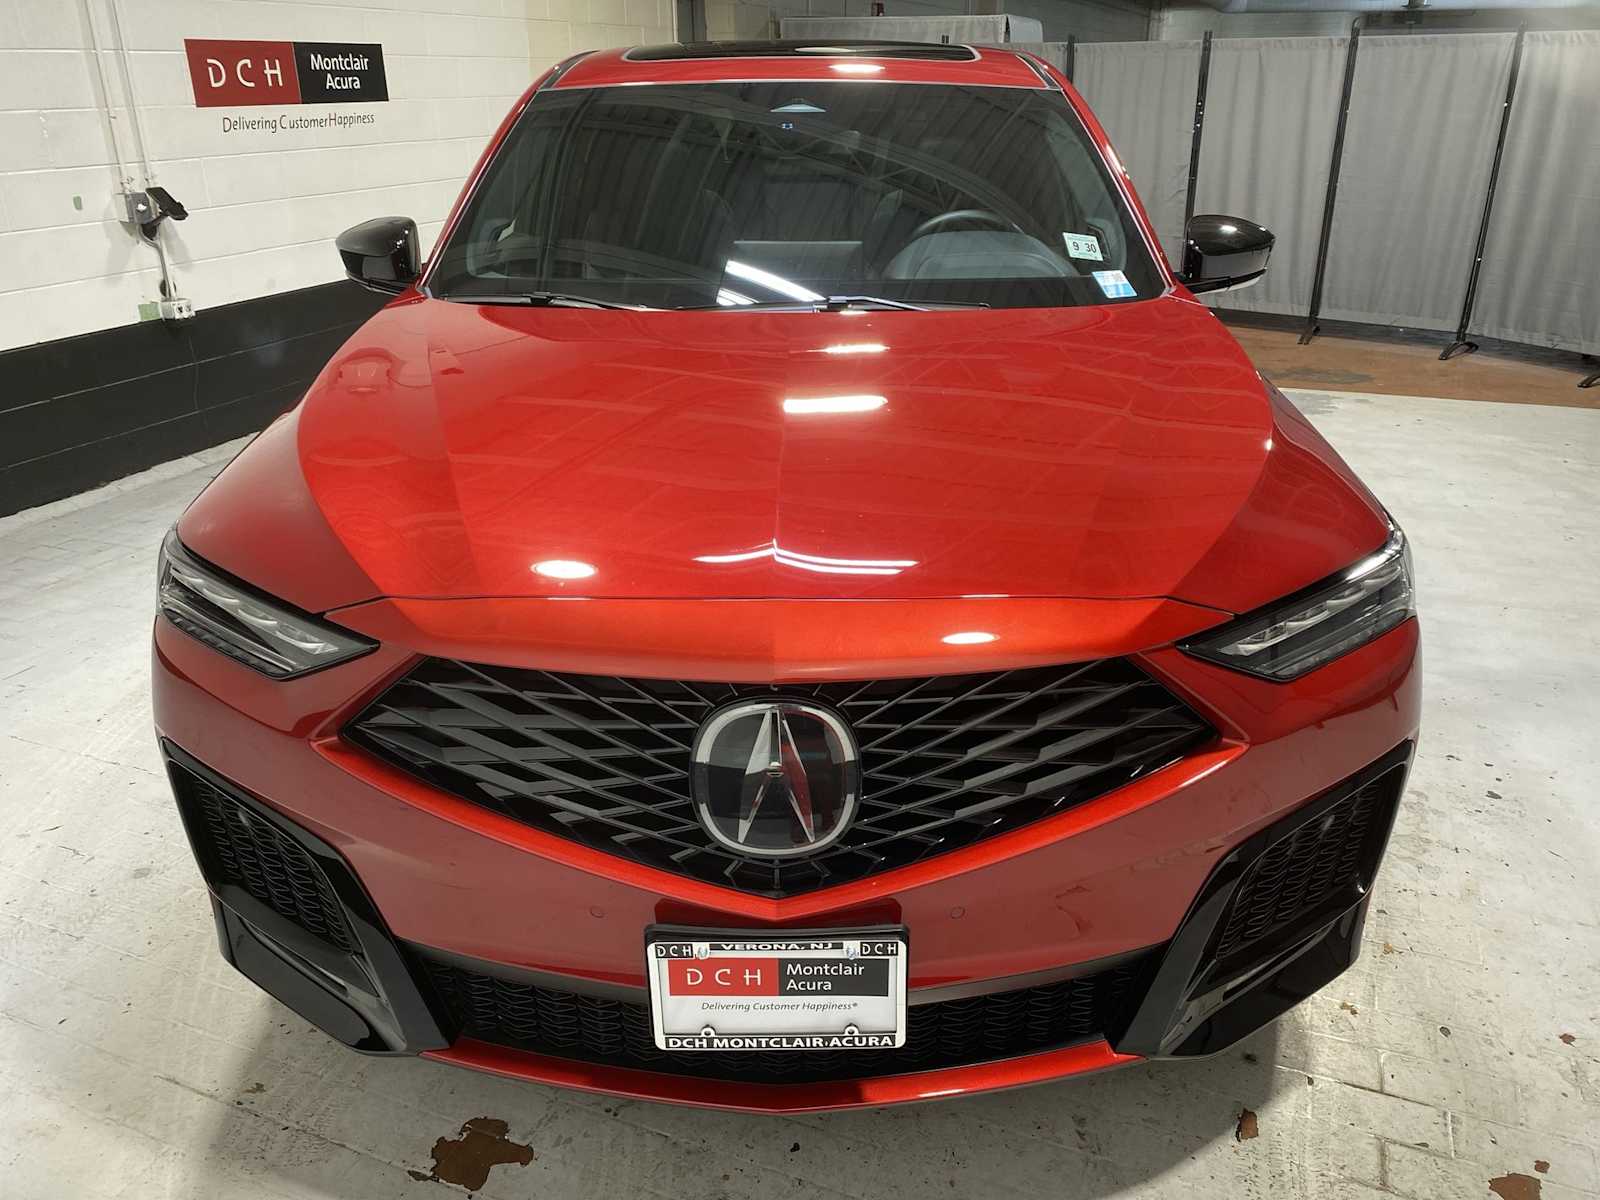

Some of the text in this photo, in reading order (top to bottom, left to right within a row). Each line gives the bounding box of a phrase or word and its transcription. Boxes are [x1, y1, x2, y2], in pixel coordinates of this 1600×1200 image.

[310, 53, 369, 71] Montclair
[206, 58, 284, 88] DCH
[325, 73, 361, 90] Acura
[222, 116, 277, 133] Delivering
[1072, 241, 1097, 253] 9 30
[657, 945, 692, 957] DCH
[862, 943, 897, 955] DCH
[786, 963, 865, 976] Montclair
[686, 968, 761, 986] DCH
[786, 979, 832, 991] Acura
[701, 1002, 750, 1012] Delivering
[752, 1002, 800, 1011] Customer
[668, 1036, 893, 1048] DCH MONTCLAIR ACURA
